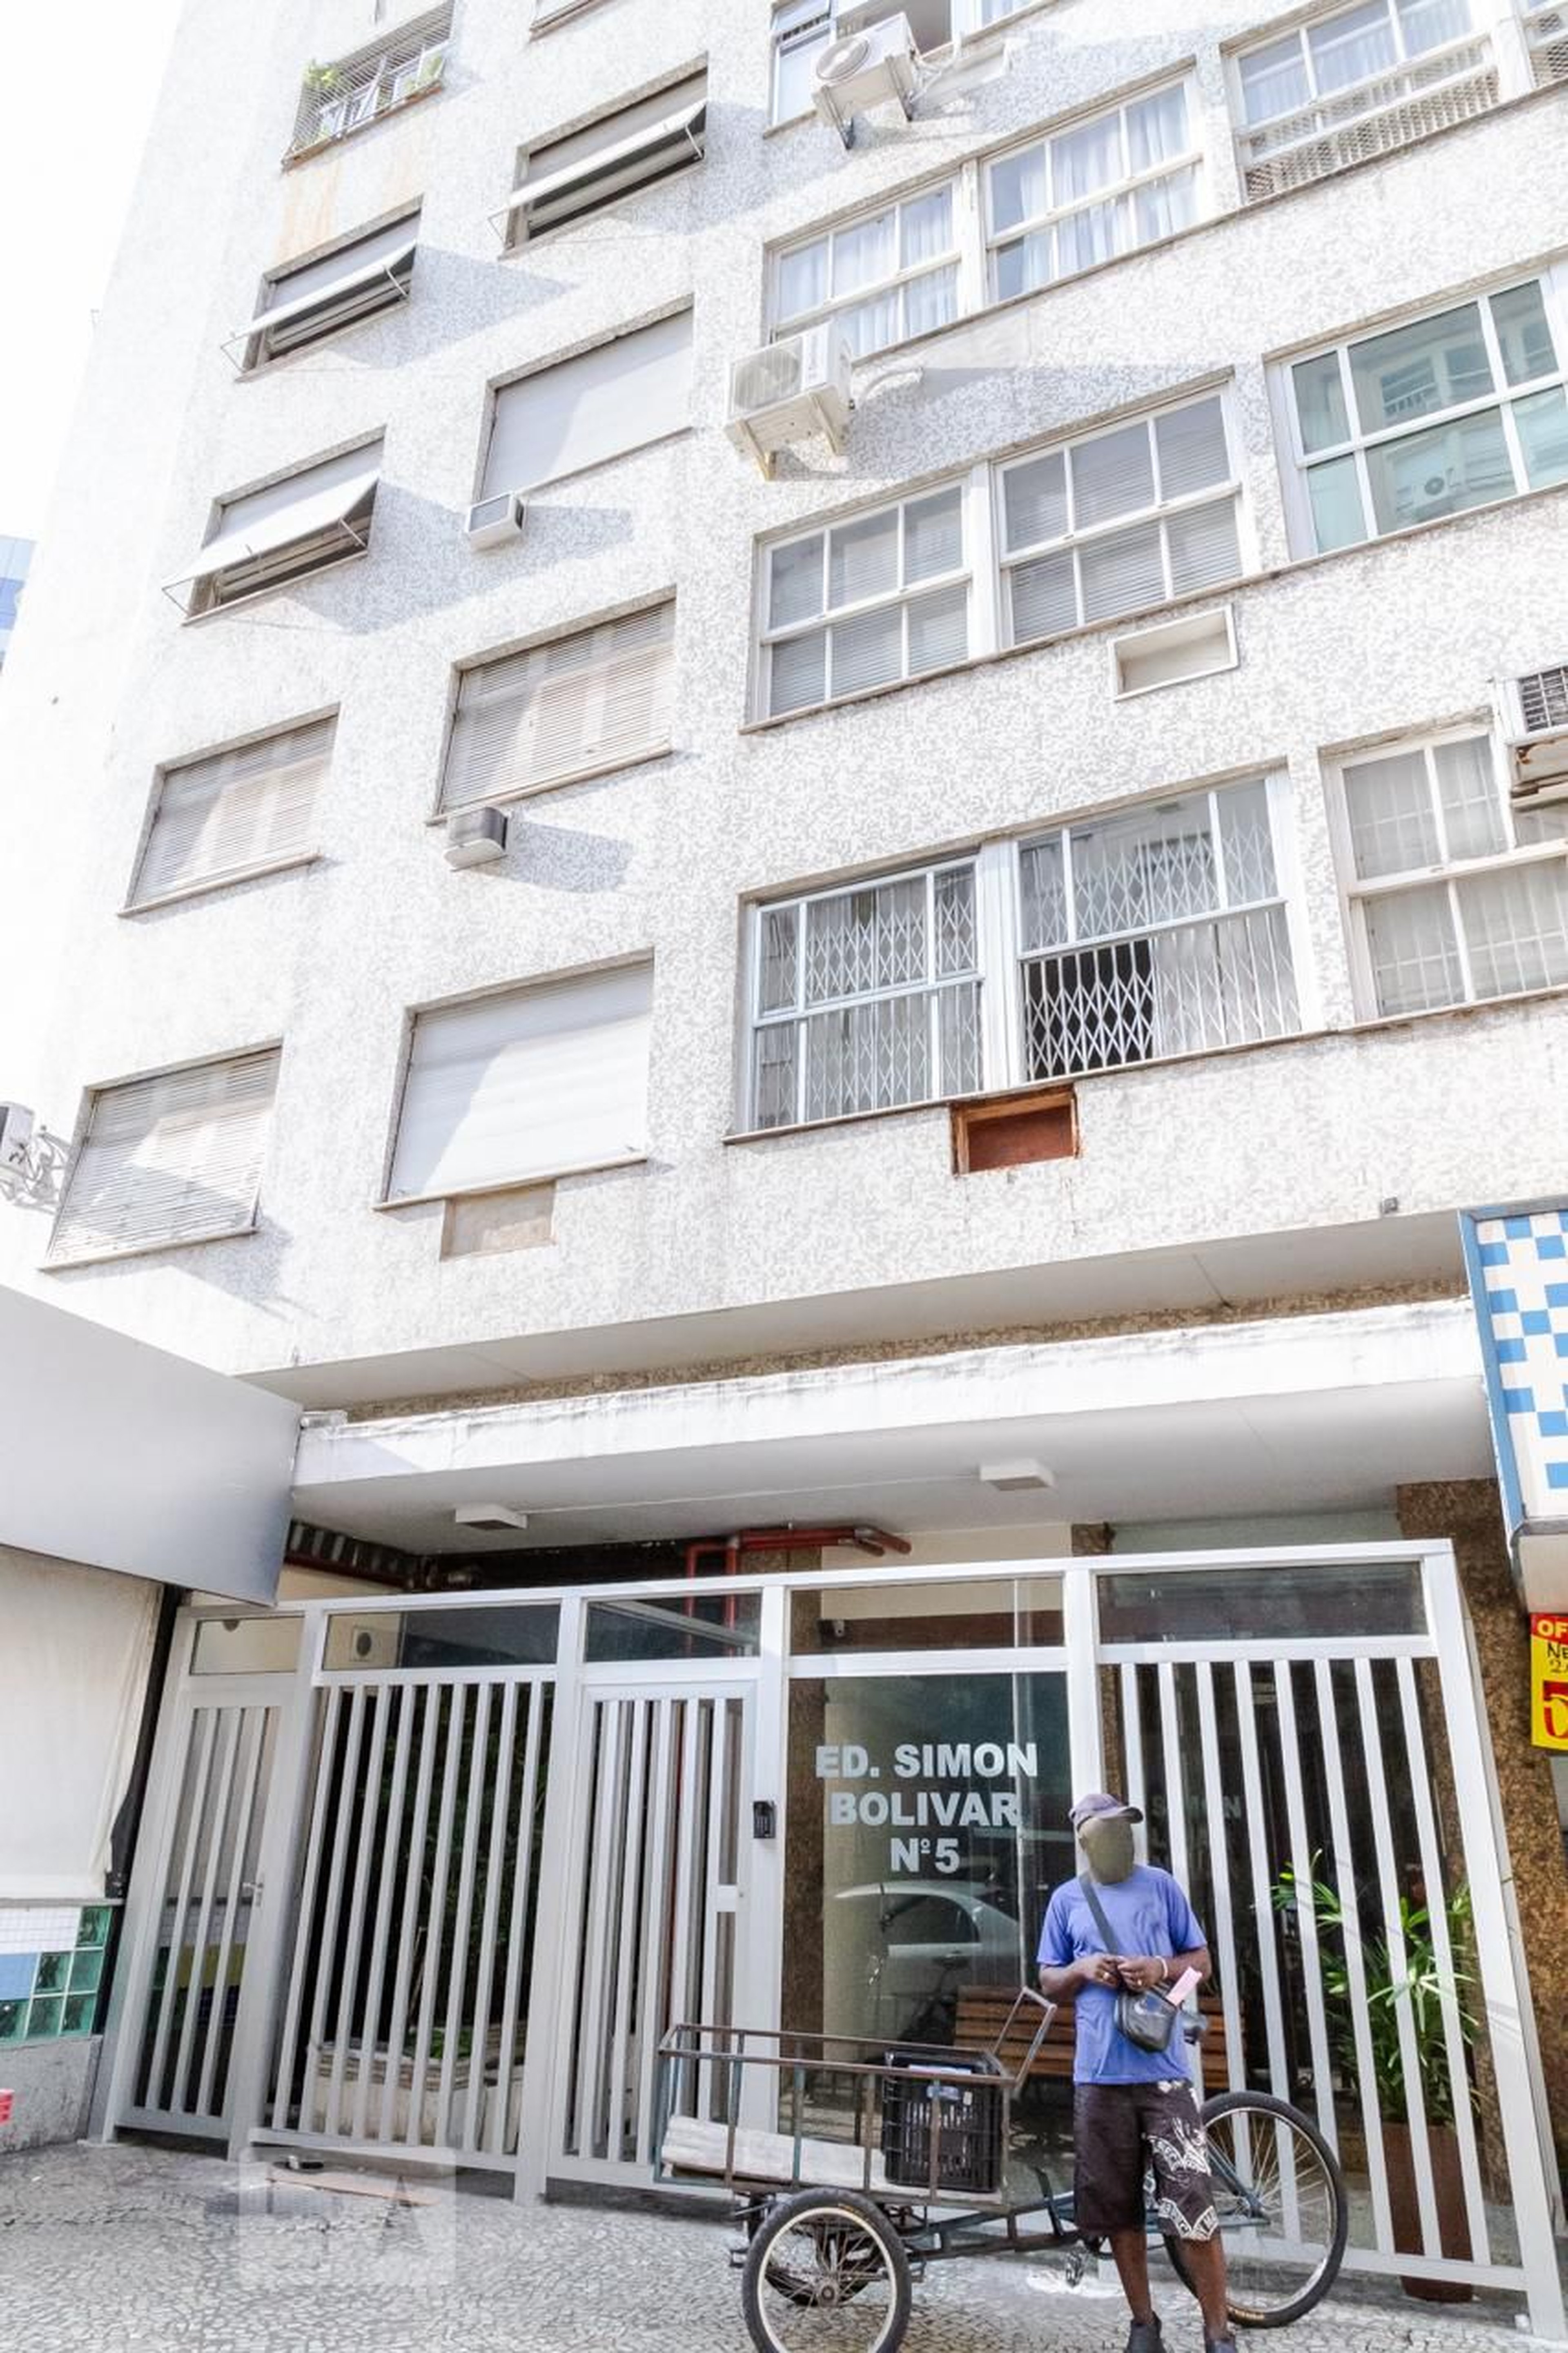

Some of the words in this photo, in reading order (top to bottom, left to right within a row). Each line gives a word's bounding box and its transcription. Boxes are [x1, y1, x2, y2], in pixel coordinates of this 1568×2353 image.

[816, 1745, 880, 1778] ED.
[894, 1742, 1038, 1778] SIMON
[830, 1791, 1019, 1826] BOLIVAR
